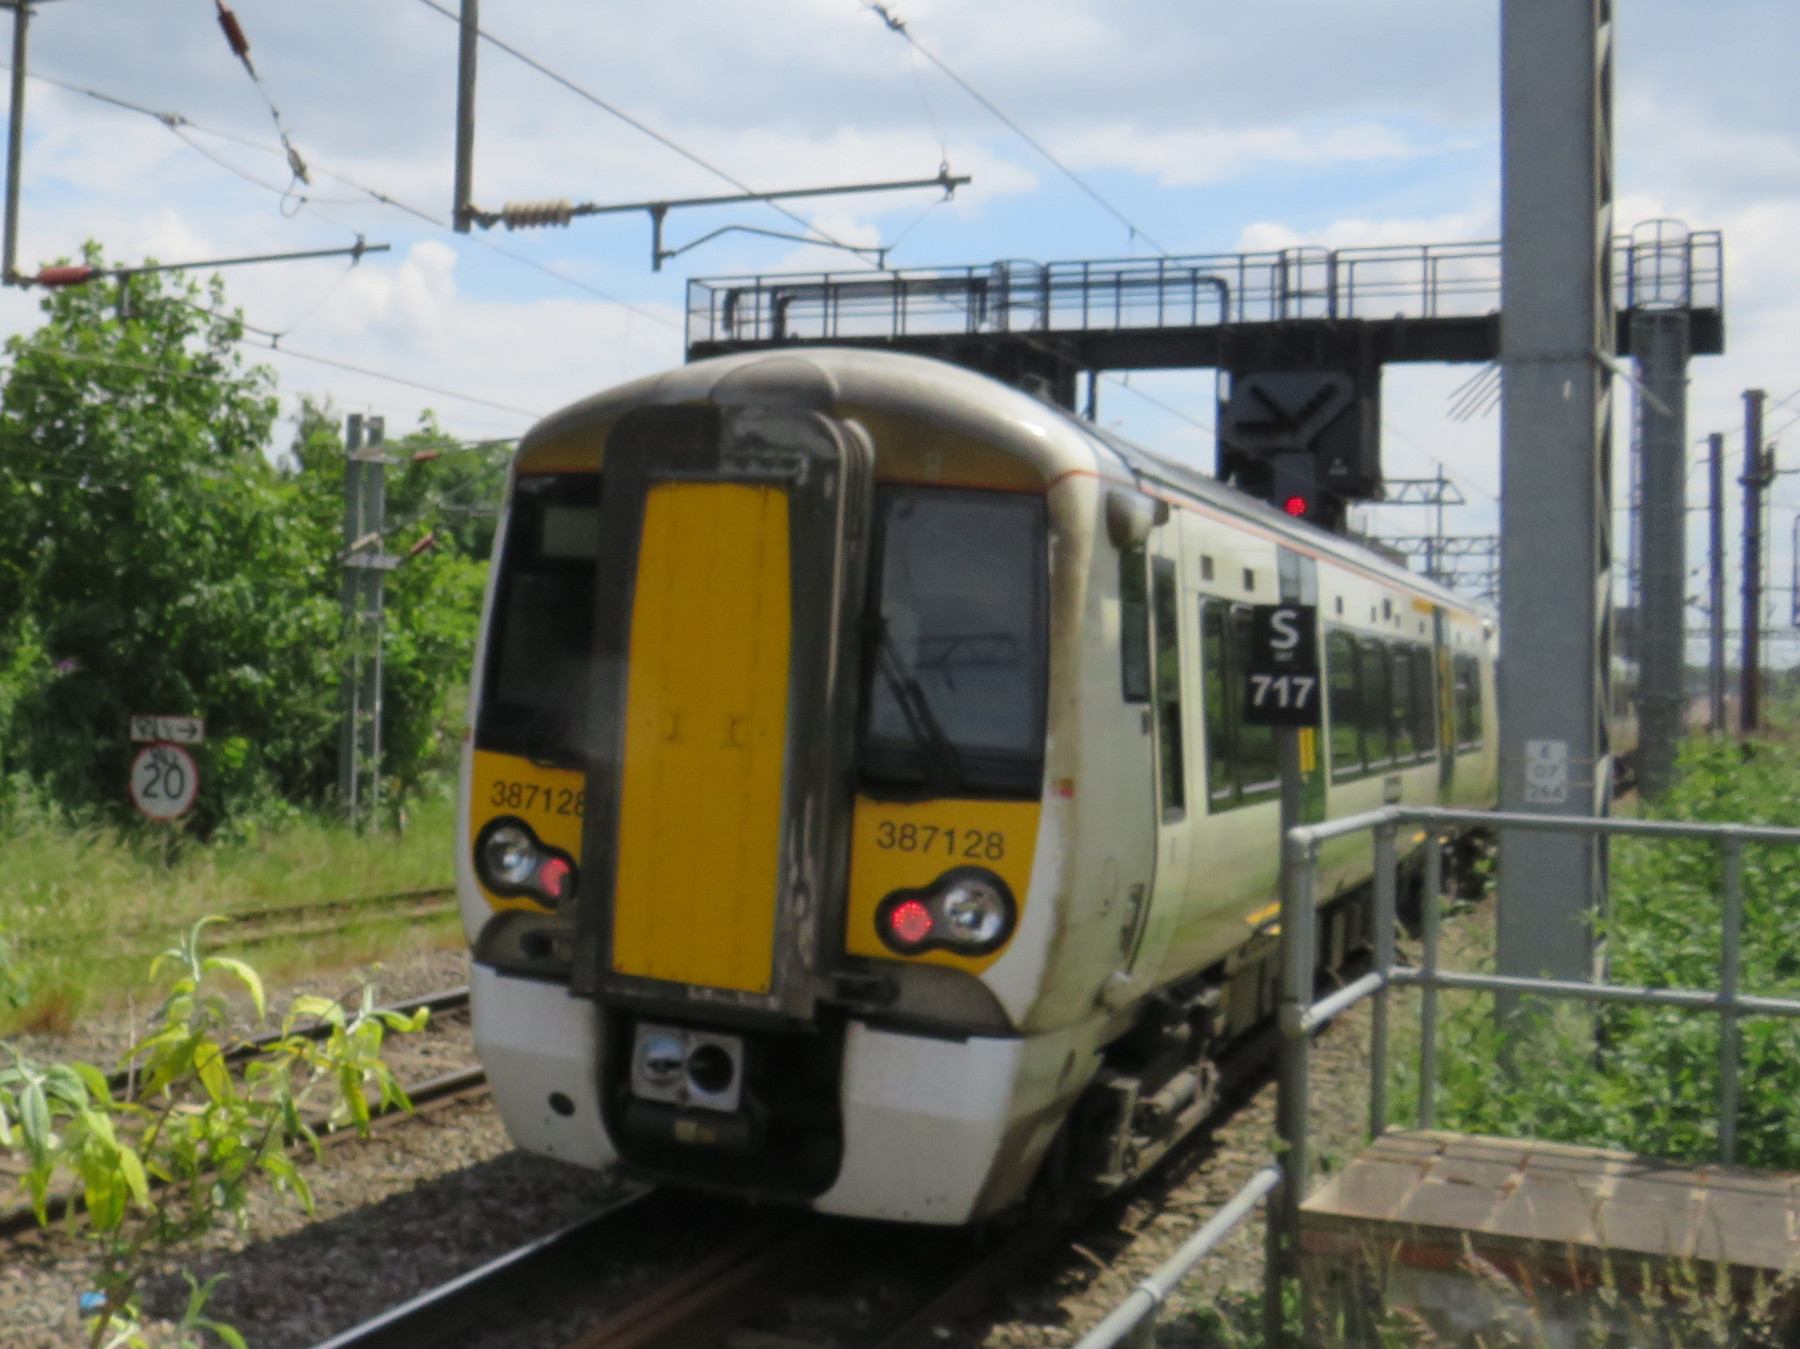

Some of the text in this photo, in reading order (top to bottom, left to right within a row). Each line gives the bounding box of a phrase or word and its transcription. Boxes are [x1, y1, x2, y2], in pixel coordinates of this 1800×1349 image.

[1270, 609, 1299, 649] S
[1250, 674, 1315, 708] 717
[142, 763, 185, 800] 20
[877, 821, 1005, 860] 387128
